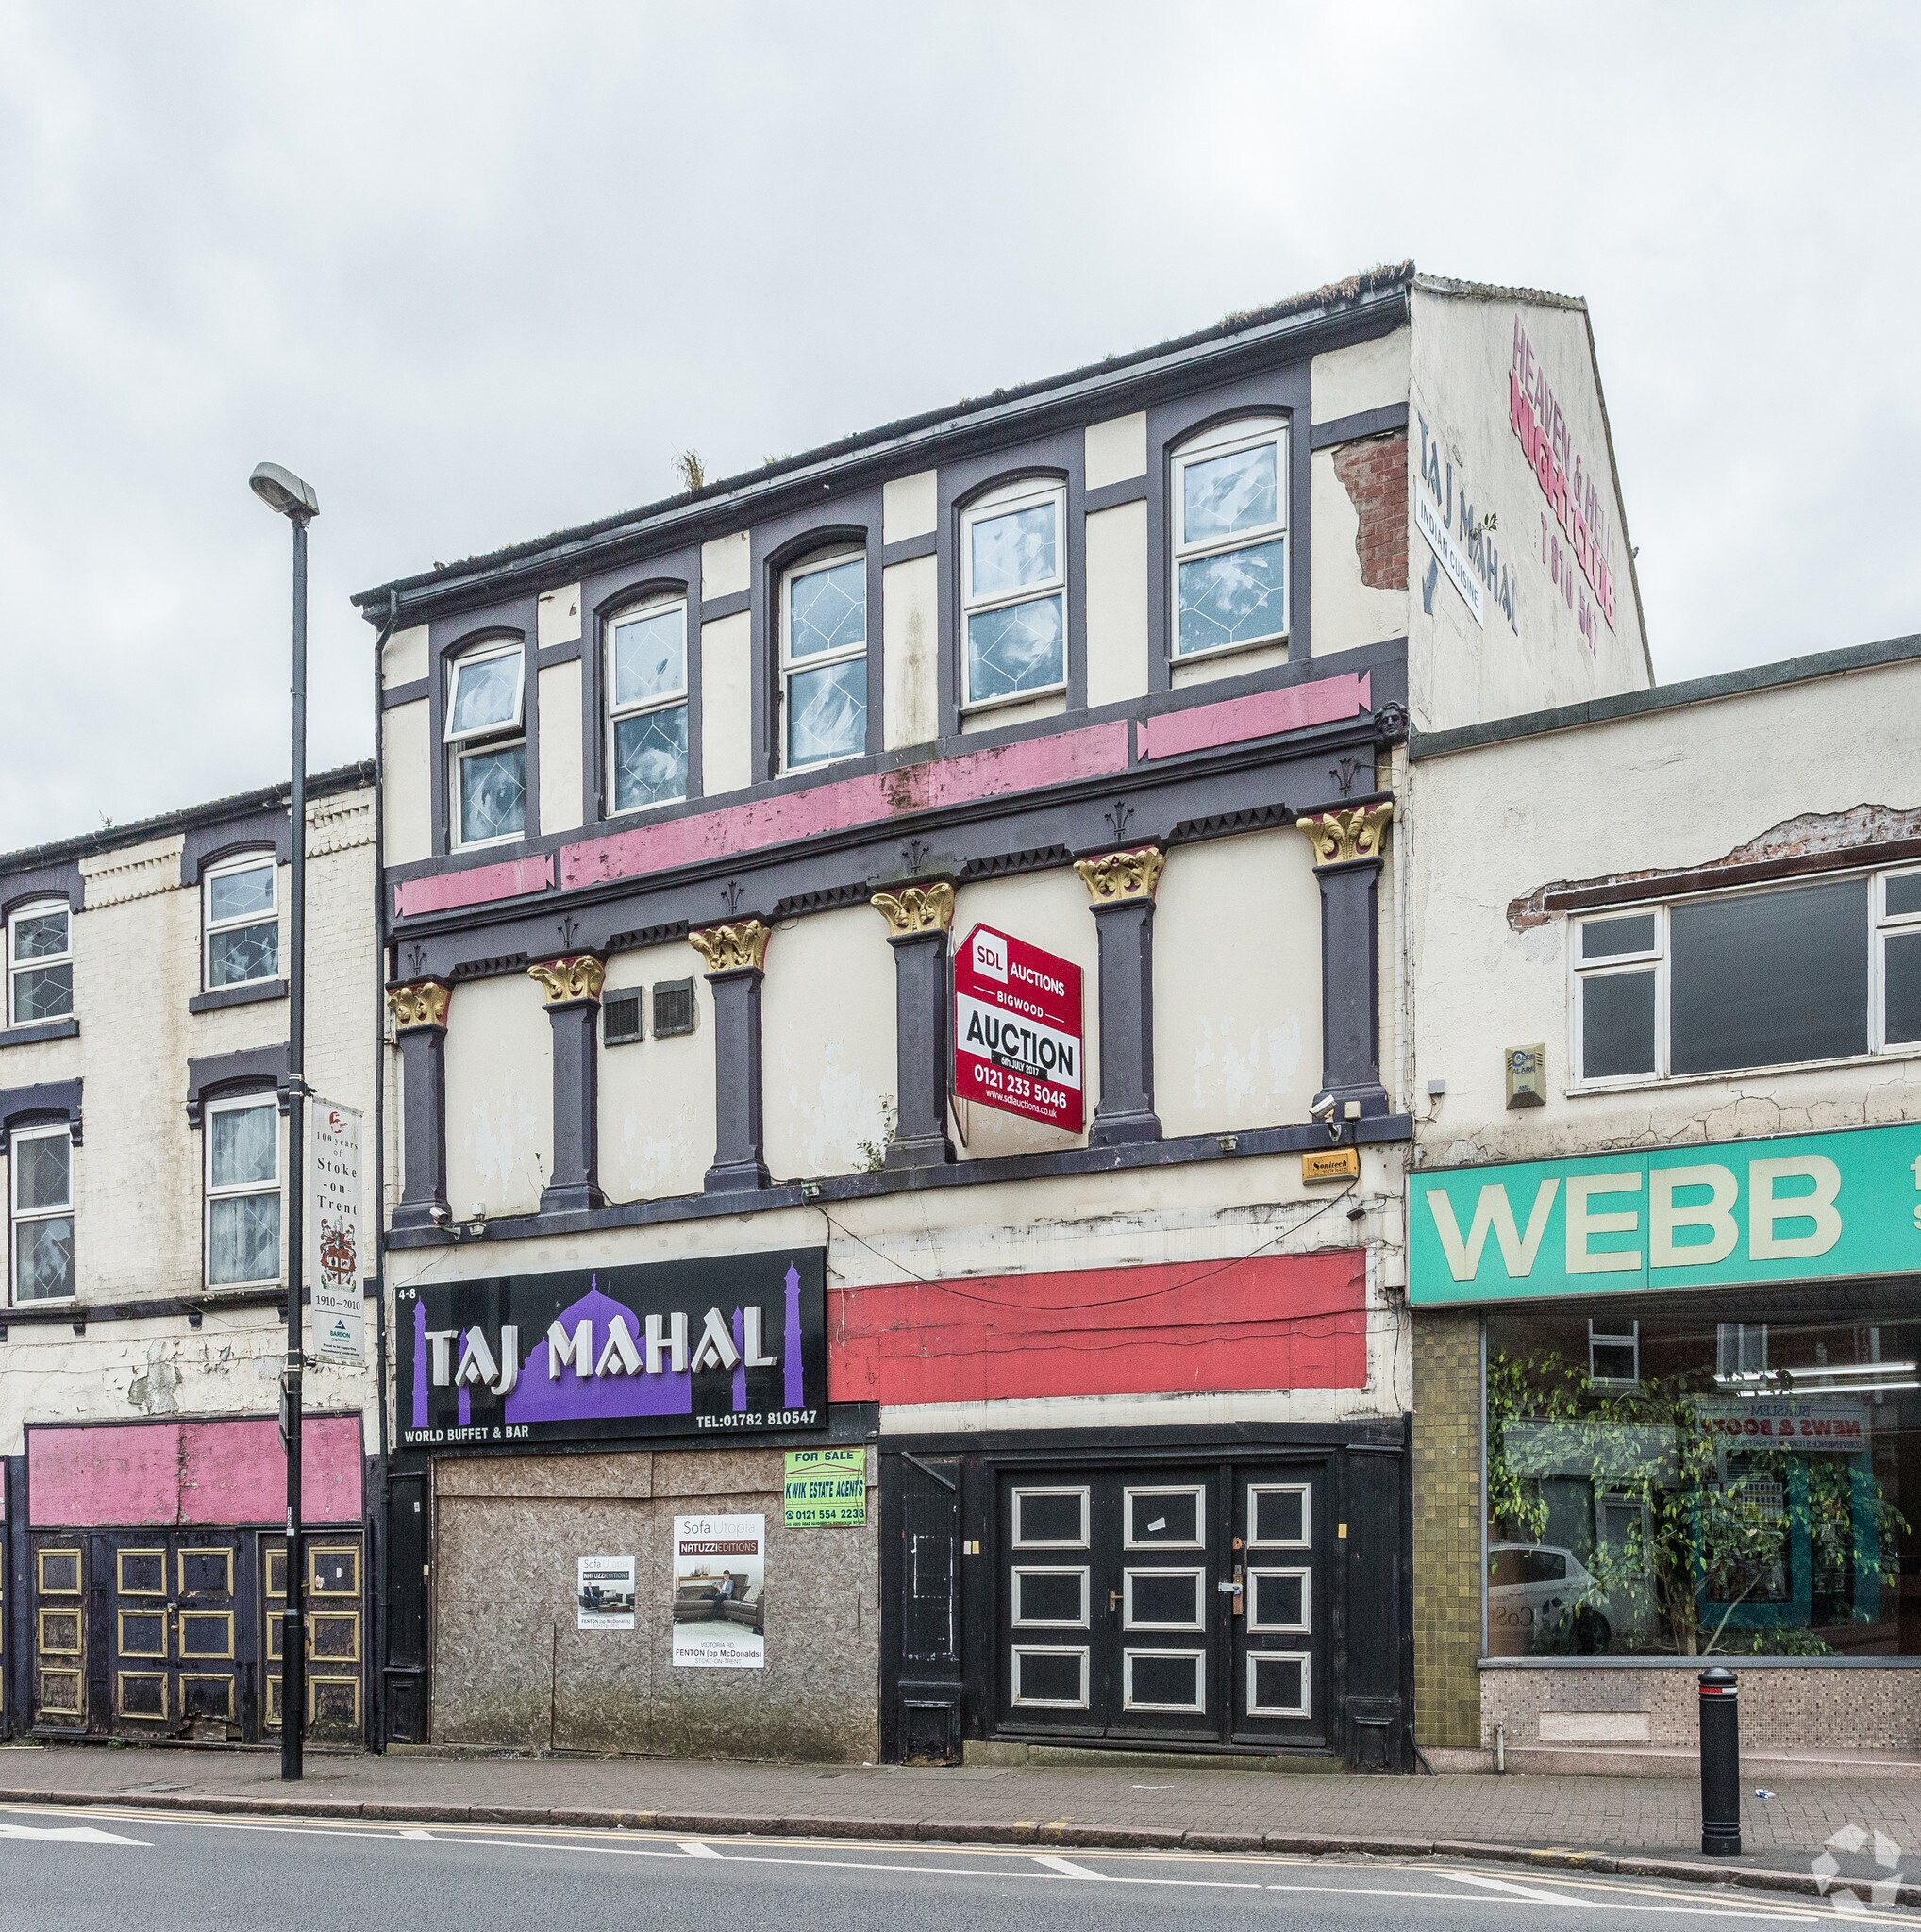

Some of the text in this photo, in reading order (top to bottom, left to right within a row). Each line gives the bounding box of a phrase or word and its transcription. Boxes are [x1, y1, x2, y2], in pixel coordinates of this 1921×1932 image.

[1513, 312, 1571, 482] HEAVEN
[1418, 409, 1518, 636] TAJ MAHAL
[1420, 499, 1479, 609] INDIAN CUISINE
[977, 945, 1065, 996] SDL AUCTIONS
[996, 991, 1044, 1018] BIGWOOD
[966, 1010, 1073, 1077] AUCTION
[1011, 1059, 1025, 1073] JULY
[1026, 1065, 1040, 1076] 2017
[974, 1064, 1067, 1109] 0121 233 5046
[985, 1089, 1057, 1119] www.sdlauctions.co.uk
[317, 1131, 359, 1150] 100 years
[317, 1157, 357, 1178] Stoke
[1313, 1159, 1347, 1170] Sonitech
[317, 1194, 357, 1215] Trent
[1424, 1154, 1843, 1282] WEBB
[398, 1288, 416, 1300] 4-8
[424, 1306, 777, 1396] TAJ MAHAL
[696, 1410, 817, 1428] TEL:01782 810547
[405, 1425, 529, 1442] WORLD BUFFET & BAR
[795, 1451, 854, 1462] FOR SALE
[785, 1480, 863, 1499] KWIK ESTATE AGENTS
[796, 1509, 864, 1520] 0121 554 2238
[683, 1520, 755, 1537] Sofa Utopia
[584, 1558, 601, 1568] Sofa
[707, 1649, 717, 1657] (op
[720, 1649, 761, 1657] McDonalds)
